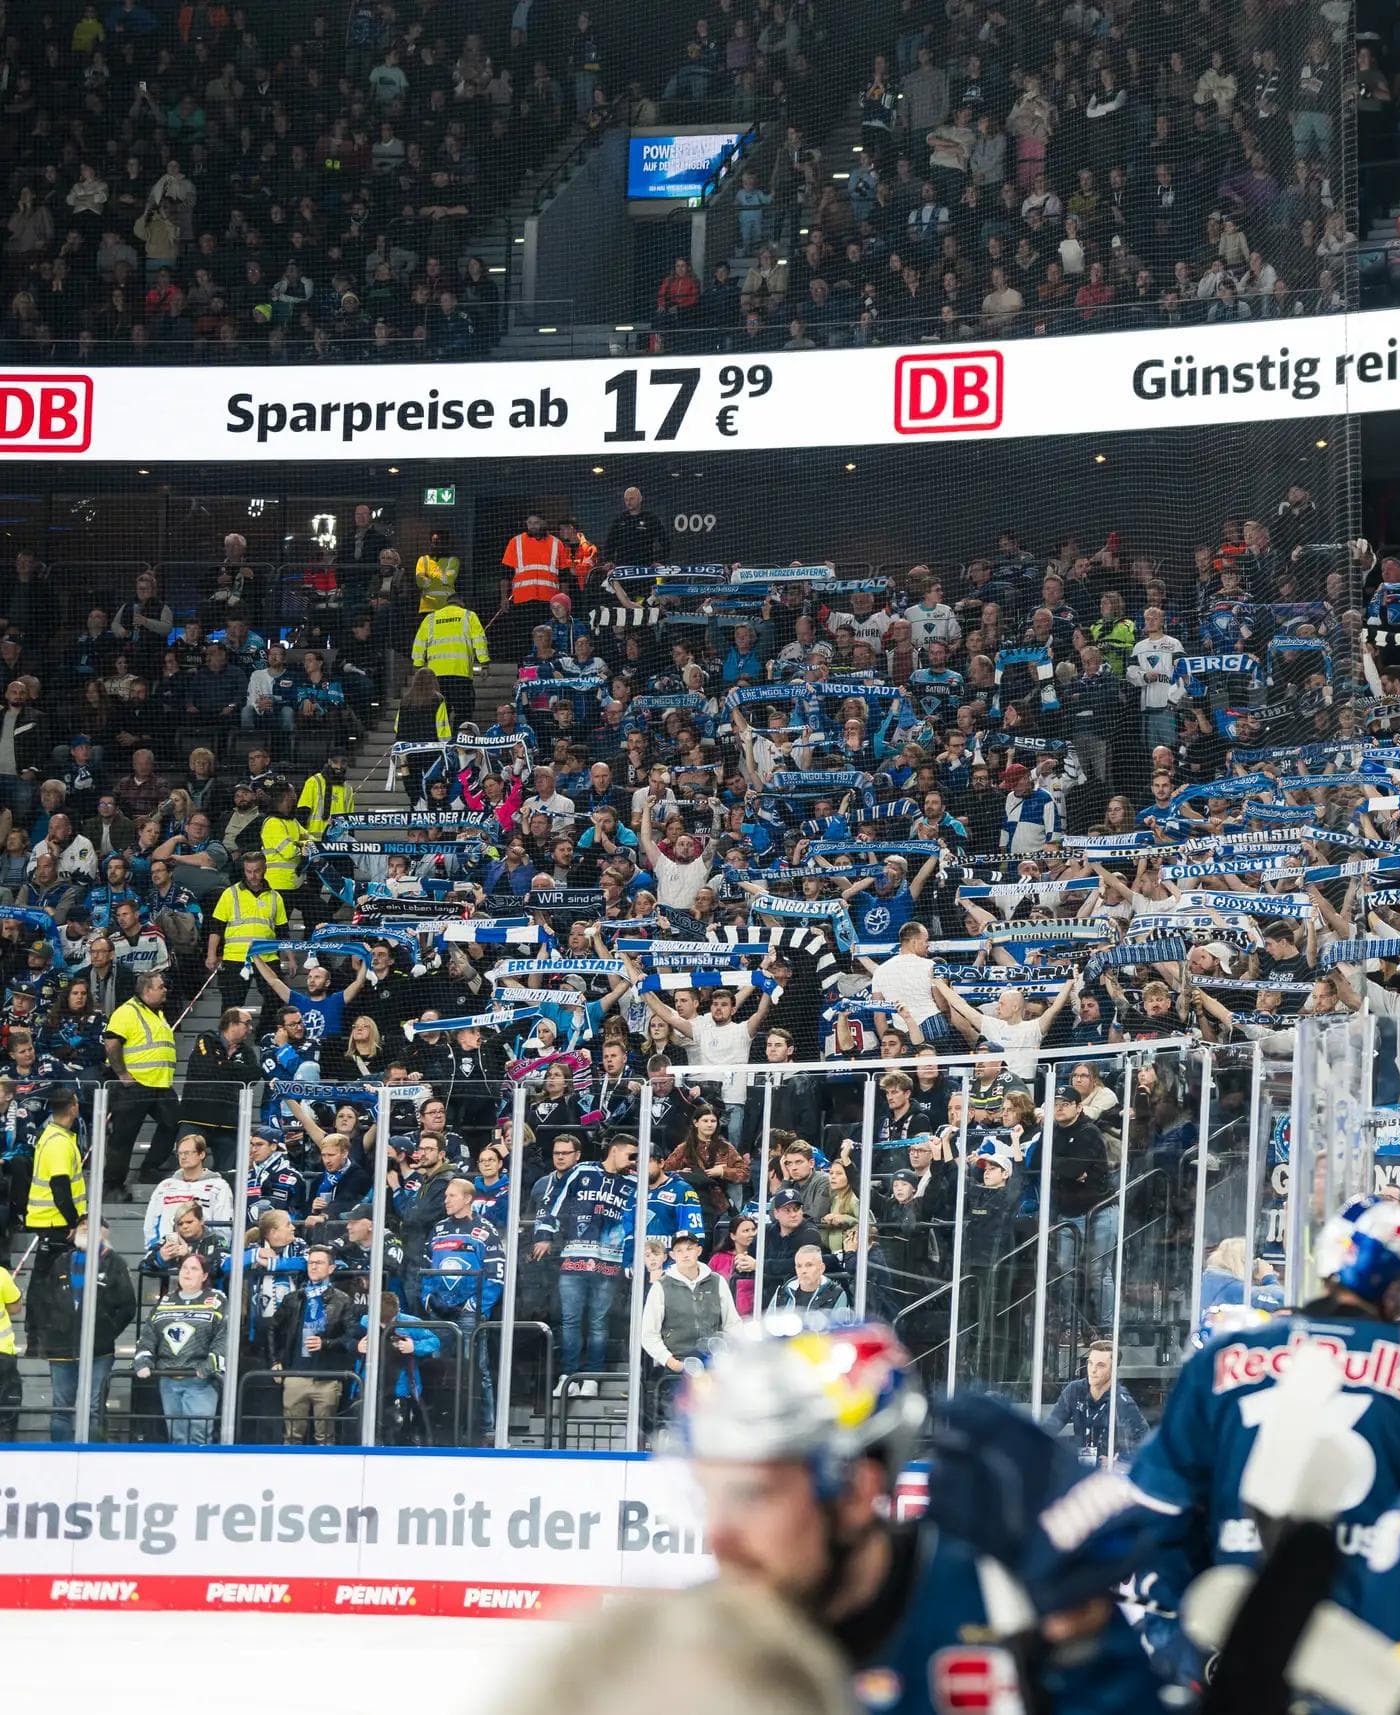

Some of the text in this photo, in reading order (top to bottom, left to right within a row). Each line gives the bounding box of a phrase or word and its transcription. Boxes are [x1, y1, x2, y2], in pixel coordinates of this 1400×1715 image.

[643, 161, 658, 173] AUF
[718, 364, 774, 398] 99
[1132, 348, 1320, 400] Günstig
[908, 366, 993, 421] DB
[226, 367, 701, 443] Sparpreise ab 17
[0, 386, 79, 441] DB
[715, 404, 740, 437] €
[673, 514, 717, 533] 009
[612, 566, 650, 578] SEIT
[435, 617, 462, 625] SECURITY
[821, 682, 901, 697] INGOLSTADT
[1014, 736, 1046, 747] ERC
[348, 811, 485, 825] DIE BESTEN FANS DER LIGA
[1221, 829, 1300, 845] INGOLSTA
[322, 841, 459, 854] WIR SIND INGOLSTADT
[1171, 857, 1276, 879] GIOVANETTI
[537, 892, 563, 904] WIR
[567, 894, 589, 903] sind
[1213, 894, 1301, 918] GIOVANETTI
[361, 904, 378, 913] ERC
[402, 904, 432, 912] Leben
[434, 904, 459, 913] lang!
[1131, 915, 1239, 931] SEIT 194
[508, 957, 624, 973] ERC INGOLSTADT
[262, 1057, 277, 1073] 19
[577, 1190, 628, 1208] SIEMENS
[388, 1246, 404, 1264] 40
[195, 1489, 379, 1546] reisen
[398, 1493, 490, 1549] mit
[507, 1496, 601, 1552] der
